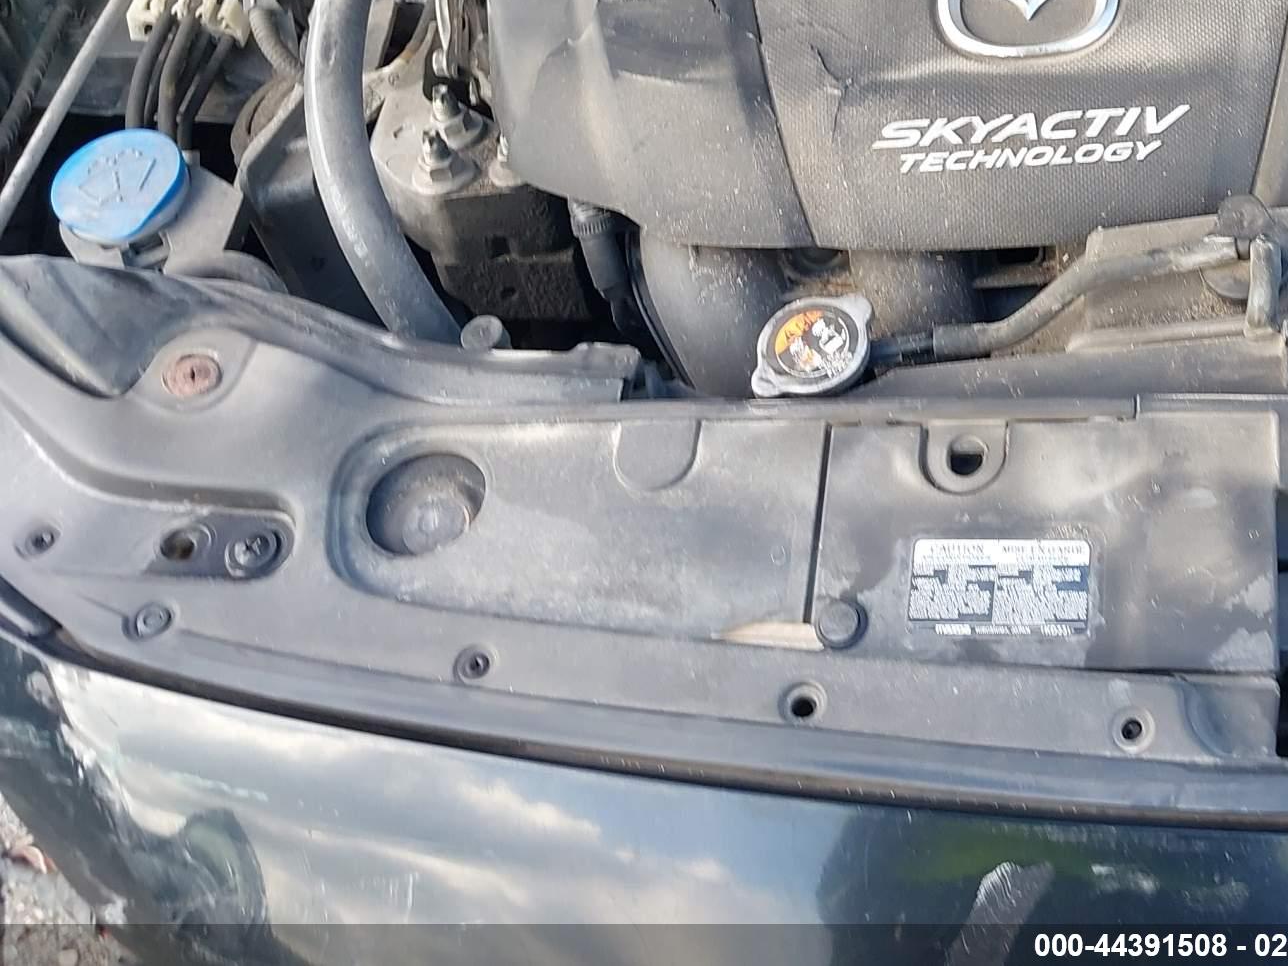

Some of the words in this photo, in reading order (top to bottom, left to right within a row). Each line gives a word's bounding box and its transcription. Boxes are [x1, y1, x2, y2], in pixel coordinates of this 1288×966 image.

[872, 104, 1191, 149] SKYACTIV
[900, 140, 1162, 173] TECHNOLOGY
[930, 544, 985, 555] CAUTION
